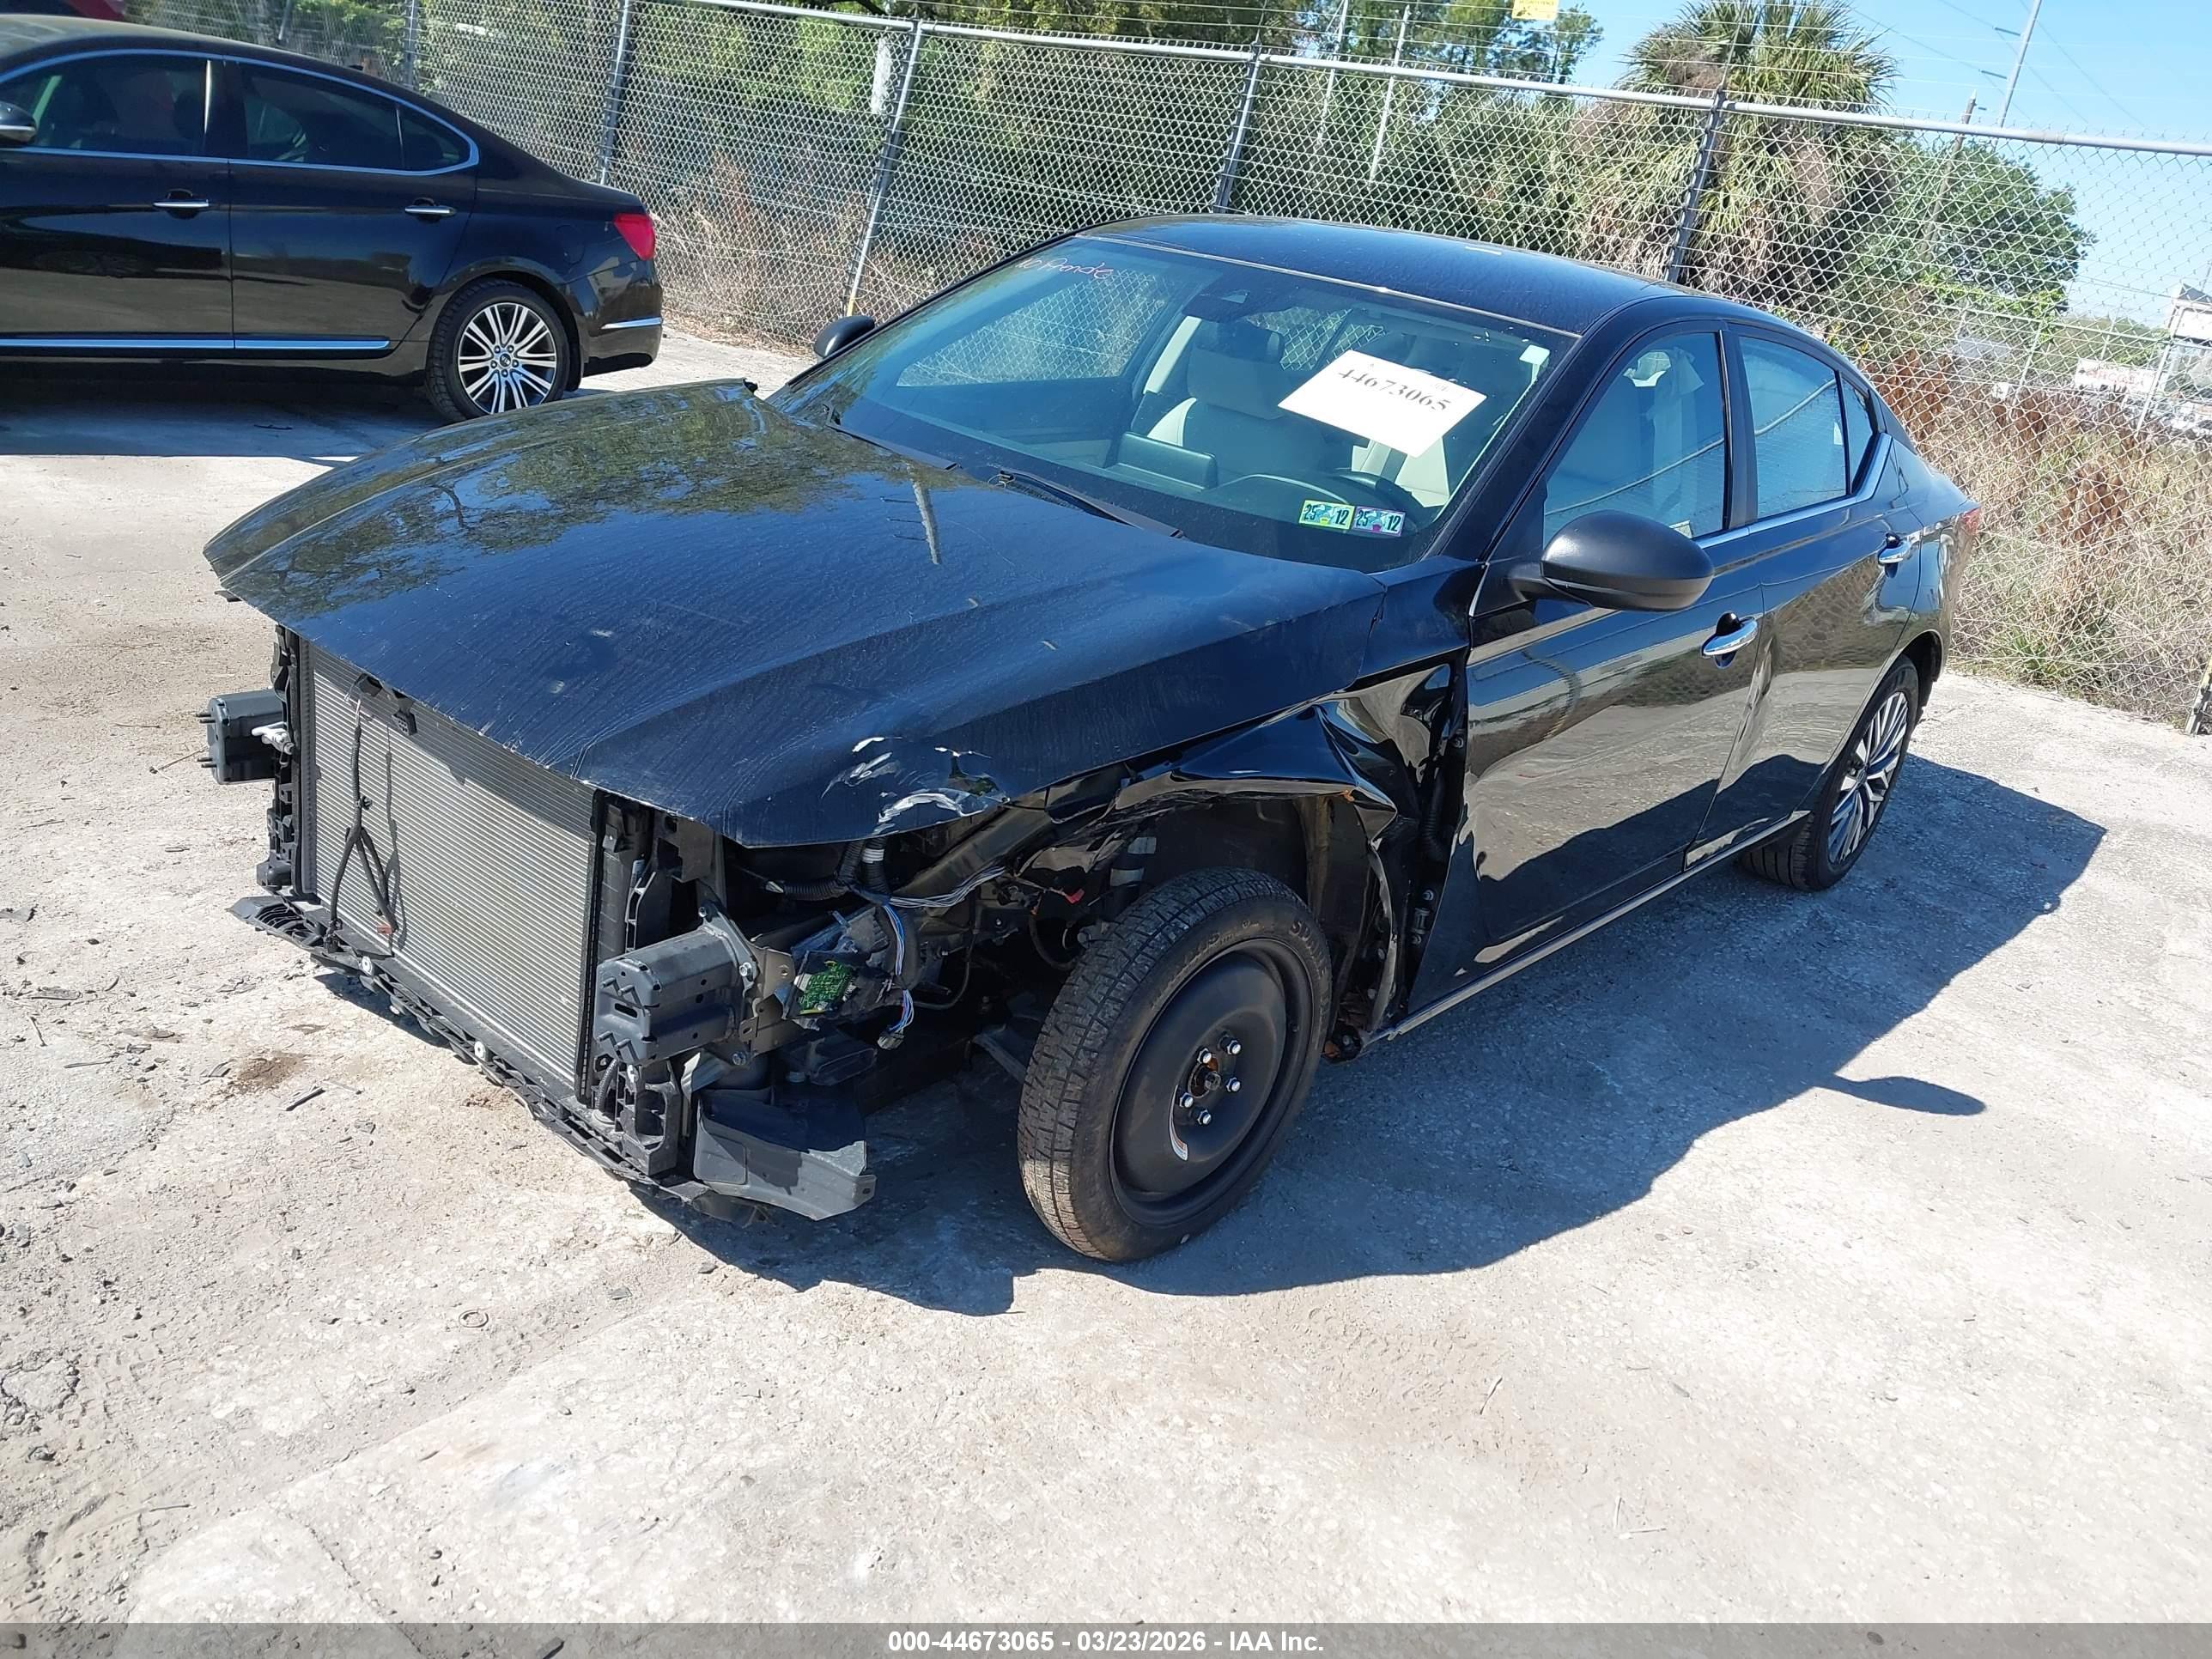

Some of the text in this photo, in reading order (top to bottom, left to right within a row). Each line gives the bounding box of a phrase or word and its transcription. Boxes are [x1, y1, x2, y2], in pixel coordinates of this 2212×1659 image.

[1339, 369, 1451, 410] 44673065
[1304, 503, 1349, 525] 25 12
[1357, 510, 1401, 532] 25 12
